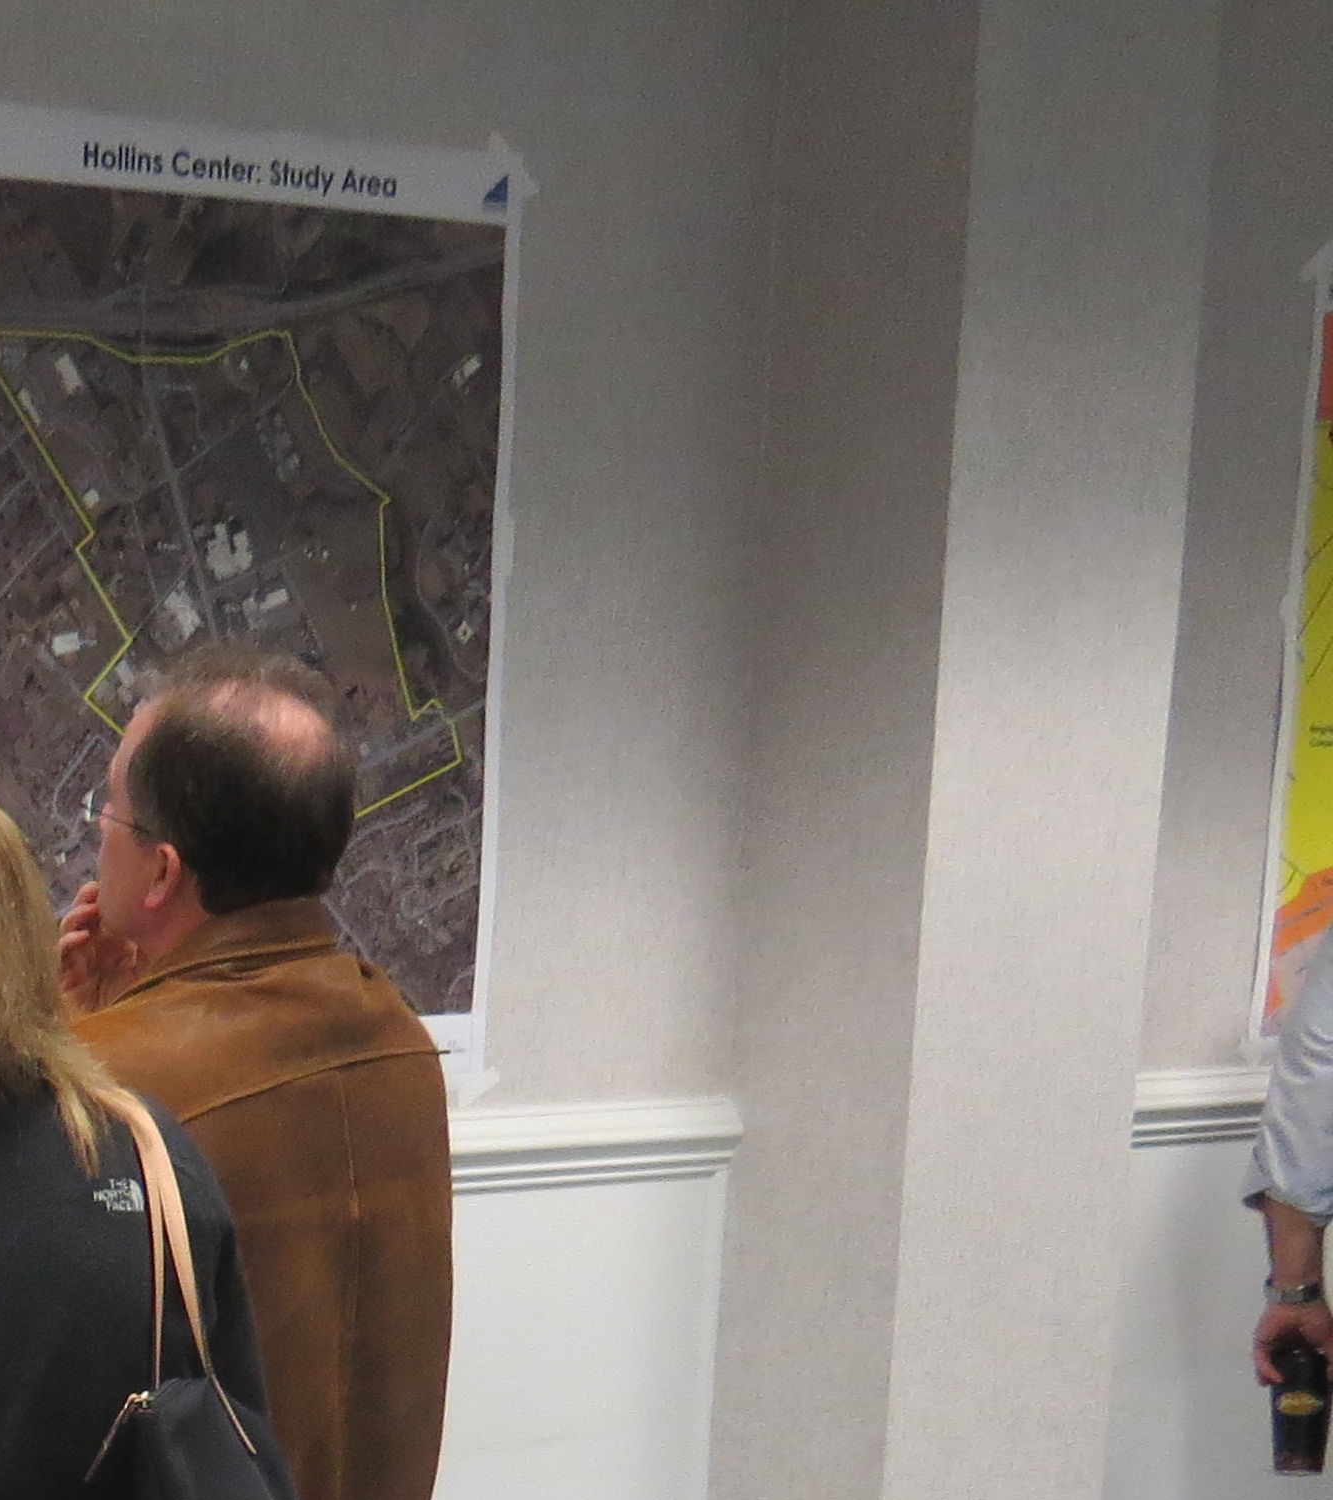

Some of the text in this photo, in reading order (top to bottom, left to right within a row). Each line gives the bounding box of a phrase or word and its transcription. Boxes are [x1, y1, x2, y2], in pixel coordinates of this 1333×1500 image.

[82, 141, 398, 198] Hollins Center: Study Area
